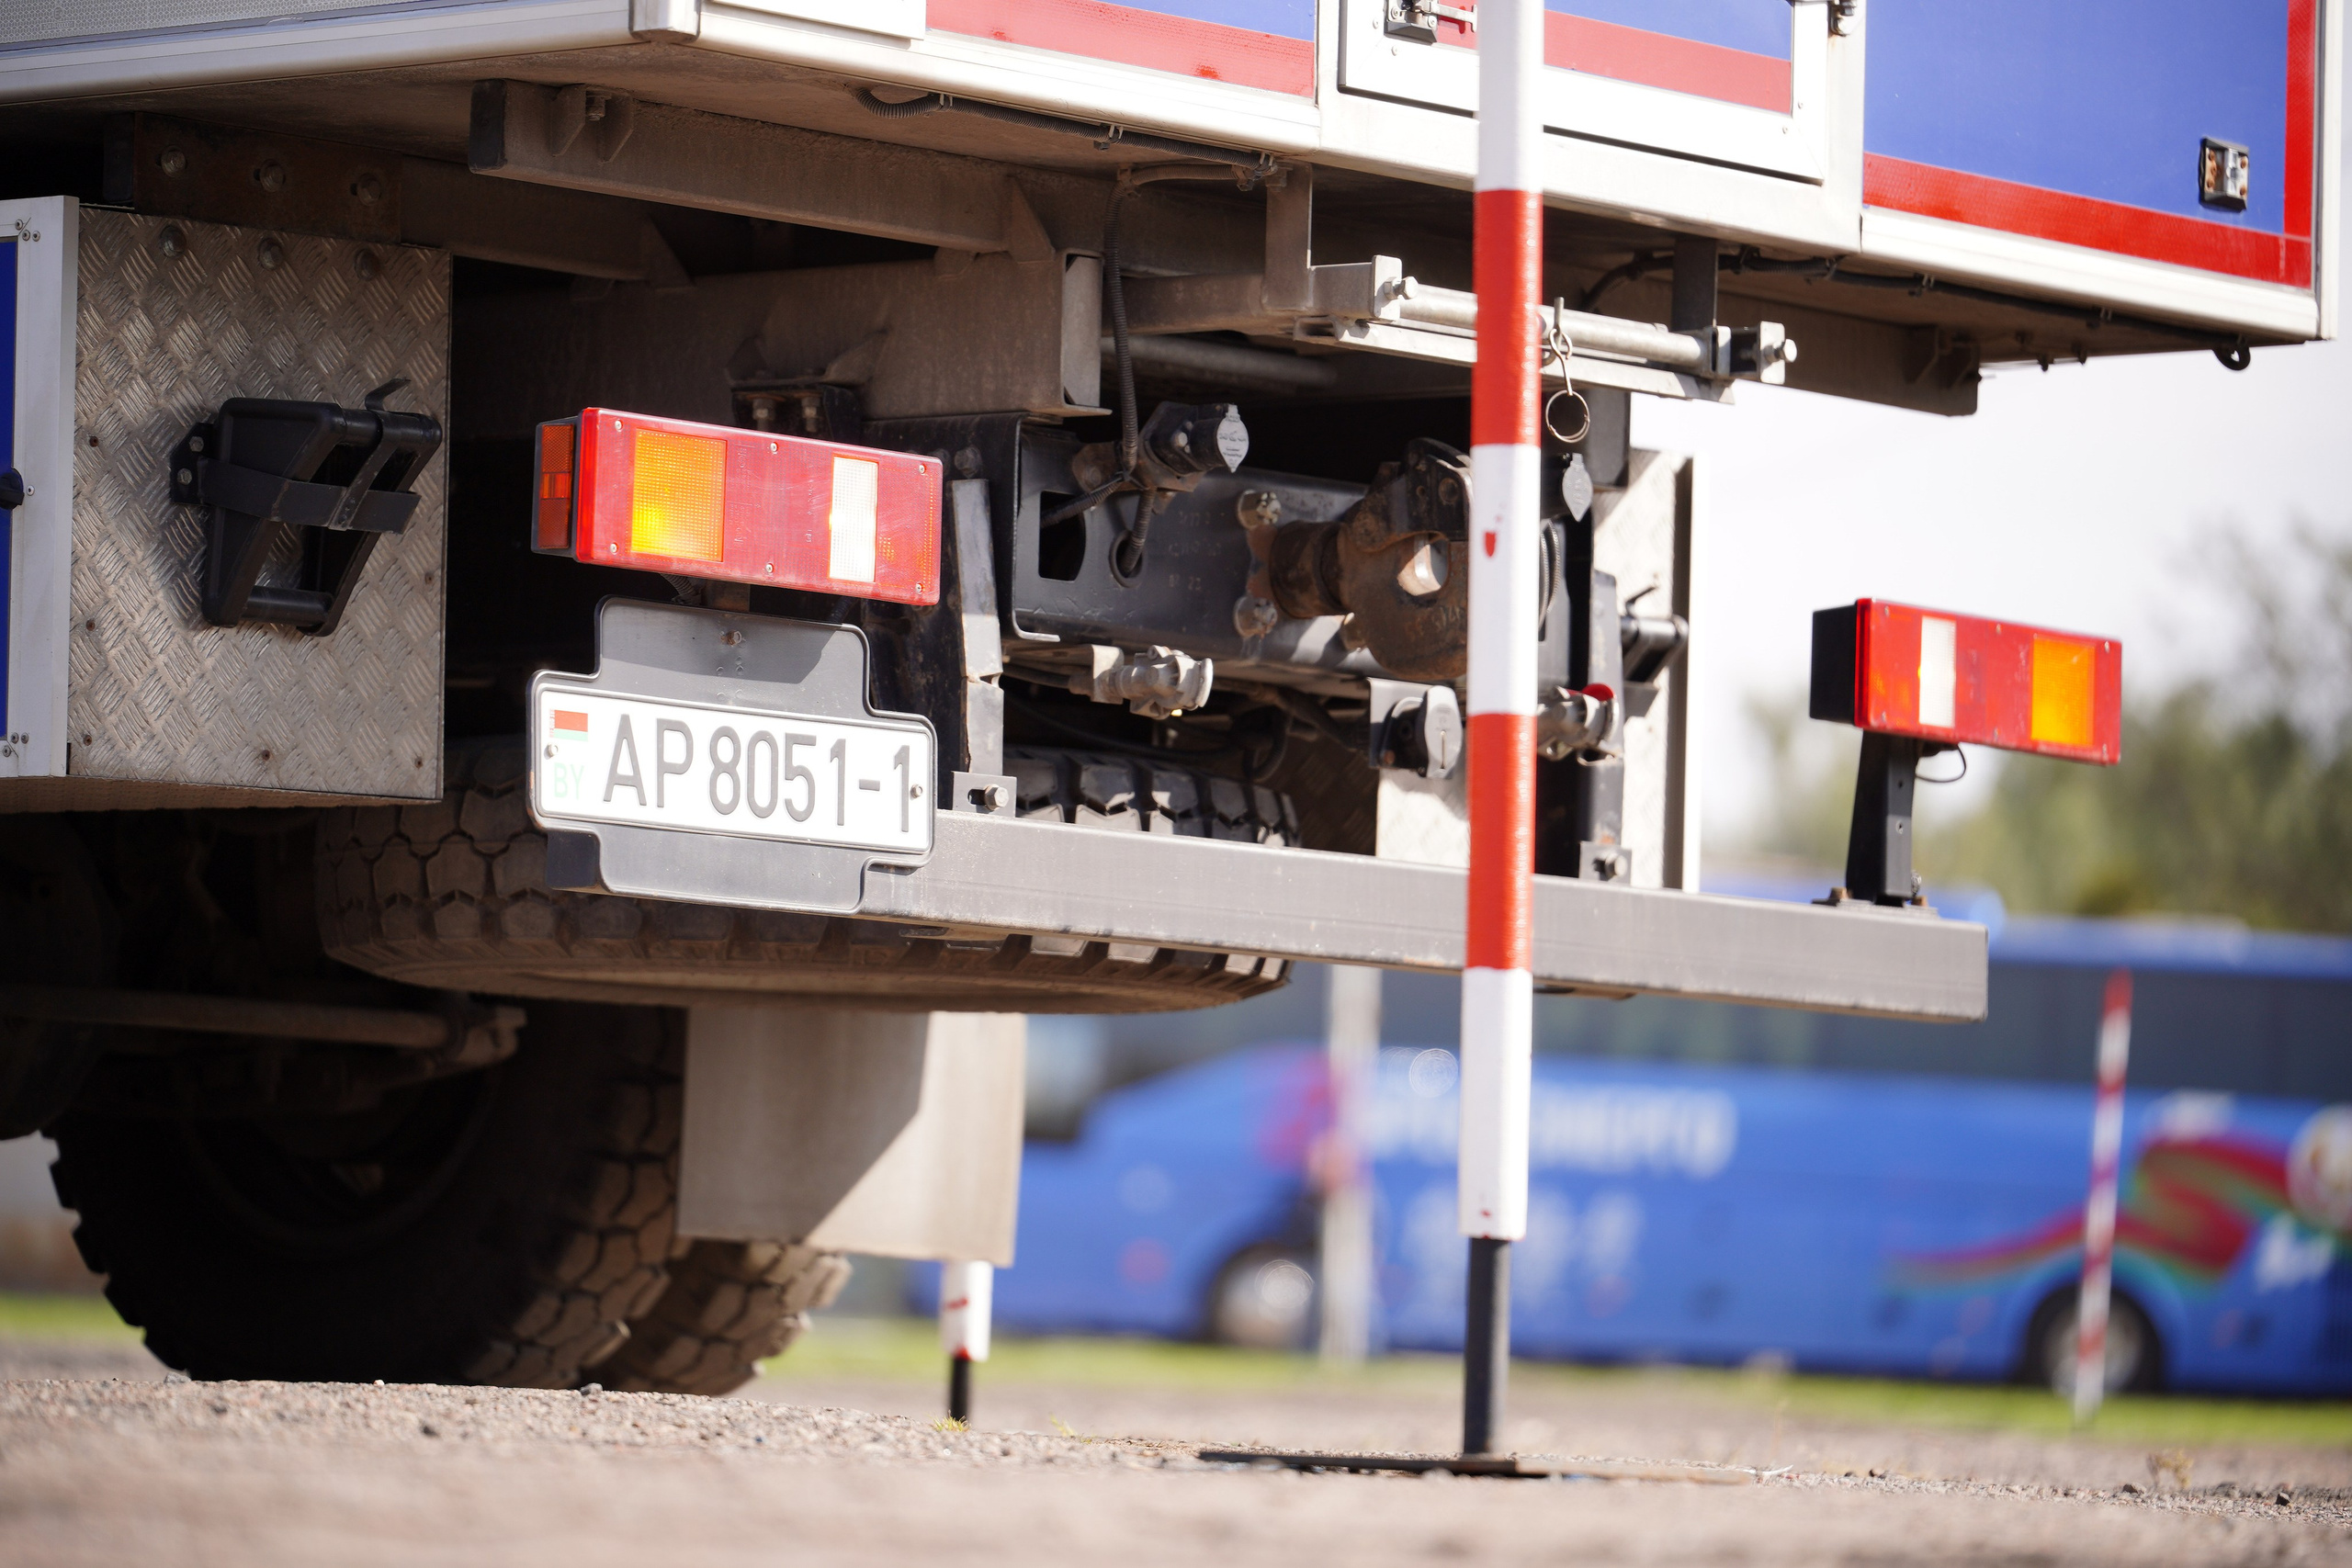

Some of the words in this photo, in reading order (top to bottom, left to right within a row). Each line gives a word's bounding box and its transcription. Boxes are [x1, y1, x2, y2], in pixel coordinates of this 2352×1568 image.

[553, 761, 585, 801] BY
[603, 713, 695, 808] AP
[708, 724, 911, 834] 8051-1
